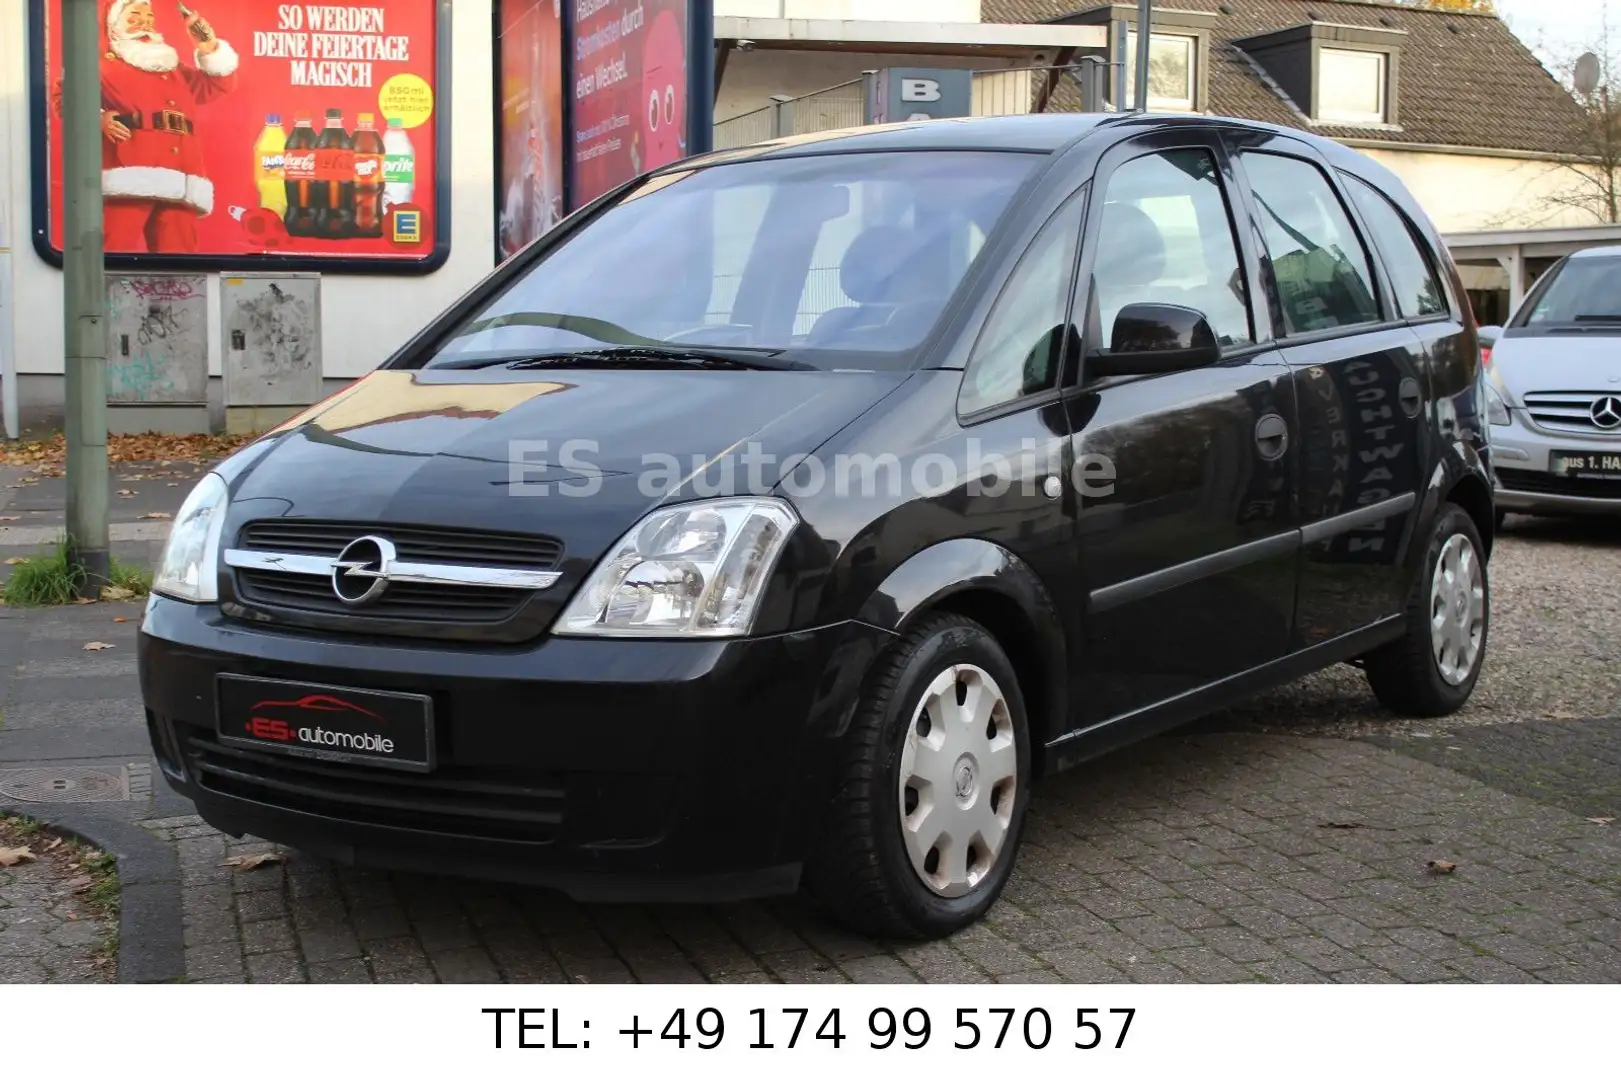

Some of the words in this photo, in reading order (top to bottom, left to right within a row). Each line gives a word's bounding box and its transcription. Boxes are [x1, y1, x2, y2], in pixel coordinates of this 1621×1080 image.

[278, 4, 303, 30] SO
[306, 5, 385, 33] WERDEN
[253, 31, 308, 58] DEINE
[311, 33, 409, 61] FEIERTAGE
[290, 60, 373, 88] MAGISCH
[576, 71, 595, 99] einen
[383, 157, 413, 173] prite
[298, 726, 395, 753] automobile
